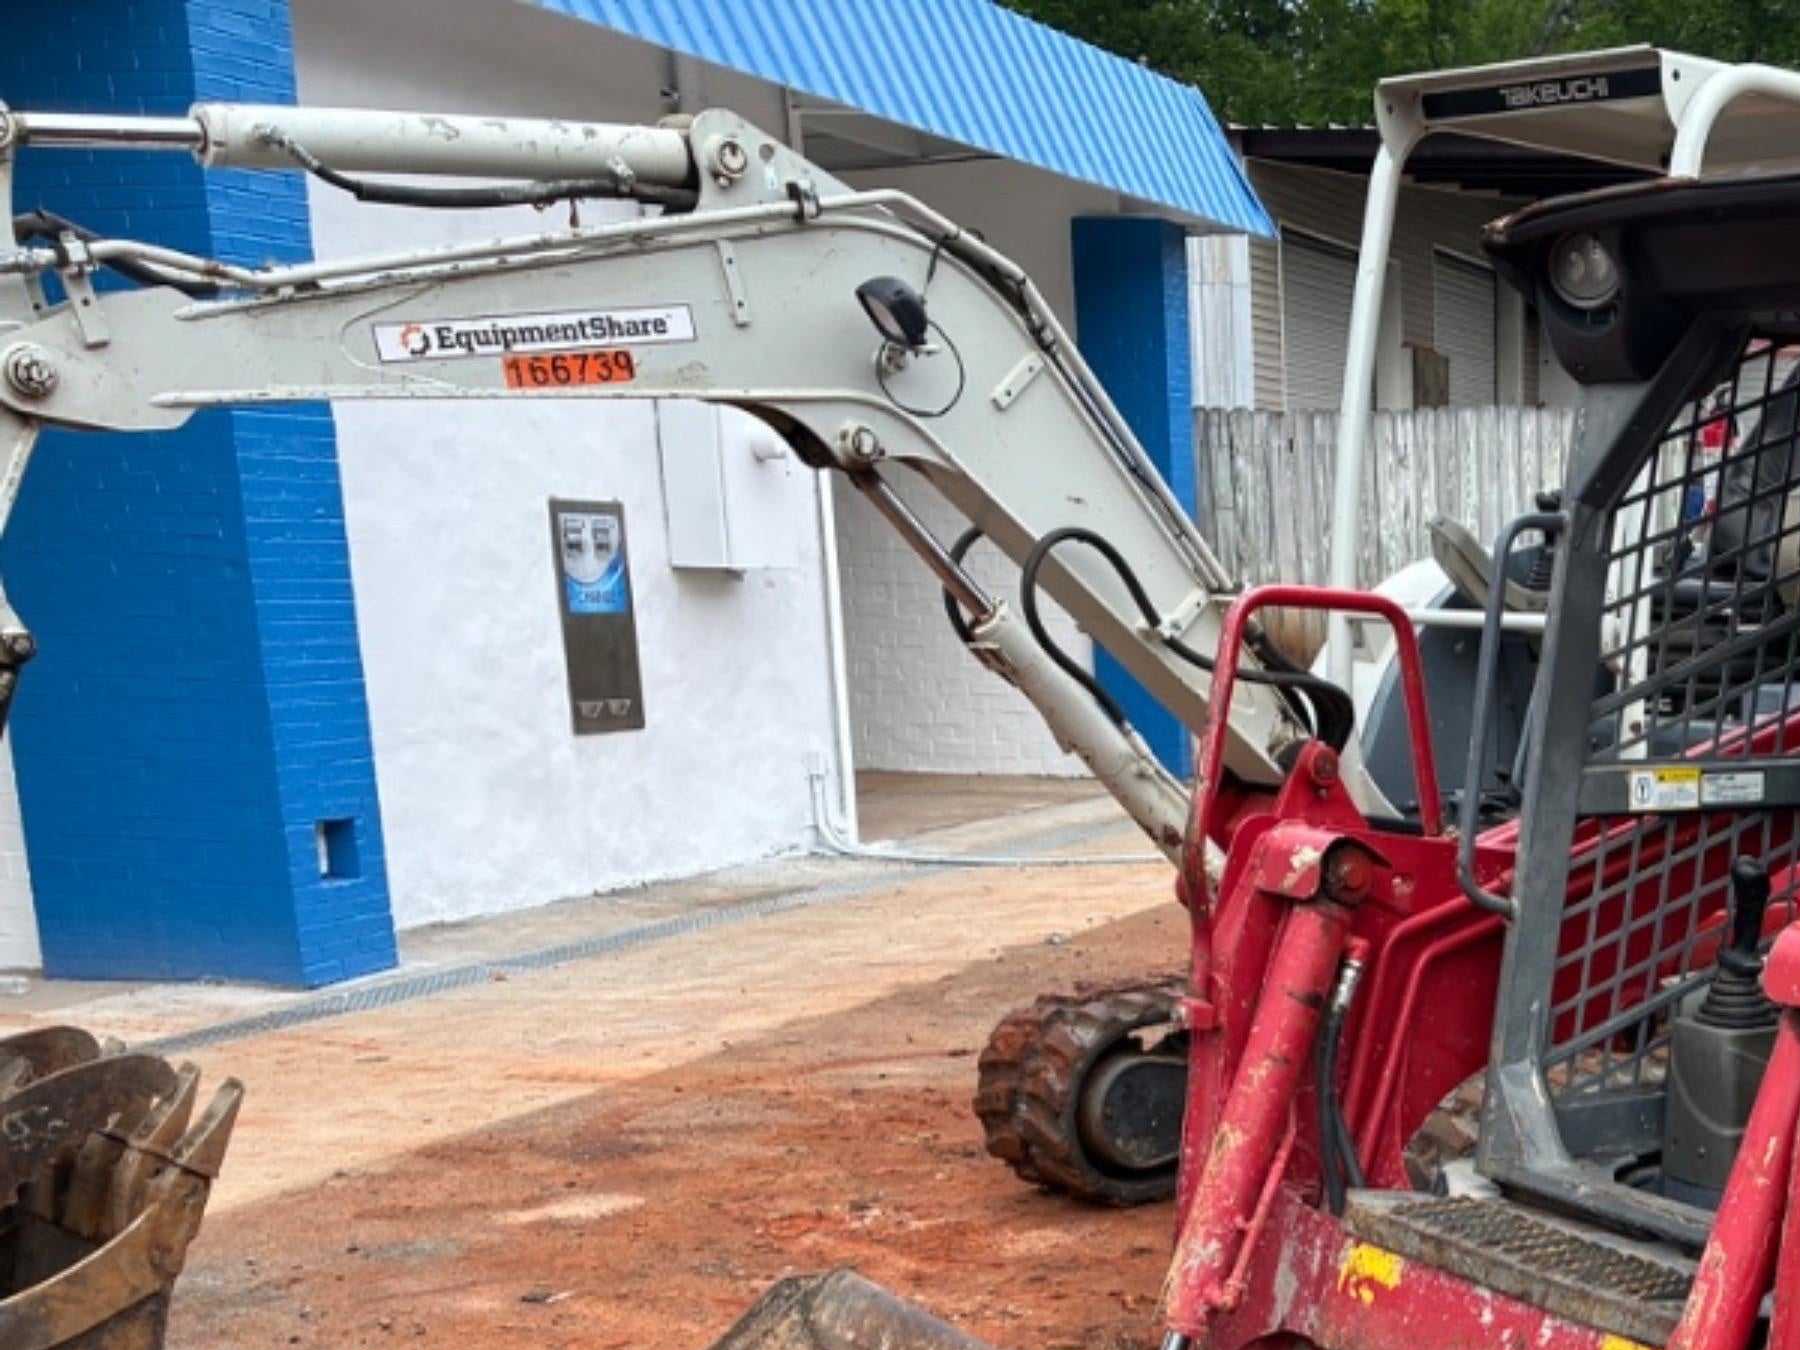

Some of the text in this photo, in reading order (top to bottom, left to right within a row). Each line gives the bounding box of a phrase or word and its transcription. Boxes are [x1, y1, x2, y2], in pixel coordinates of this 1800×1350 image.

[1500, 77, 1609, 106] TAKEUCHI
[435, 314, 668, 355] EquipmentShare
[504, 350, 635, 388] 166739
